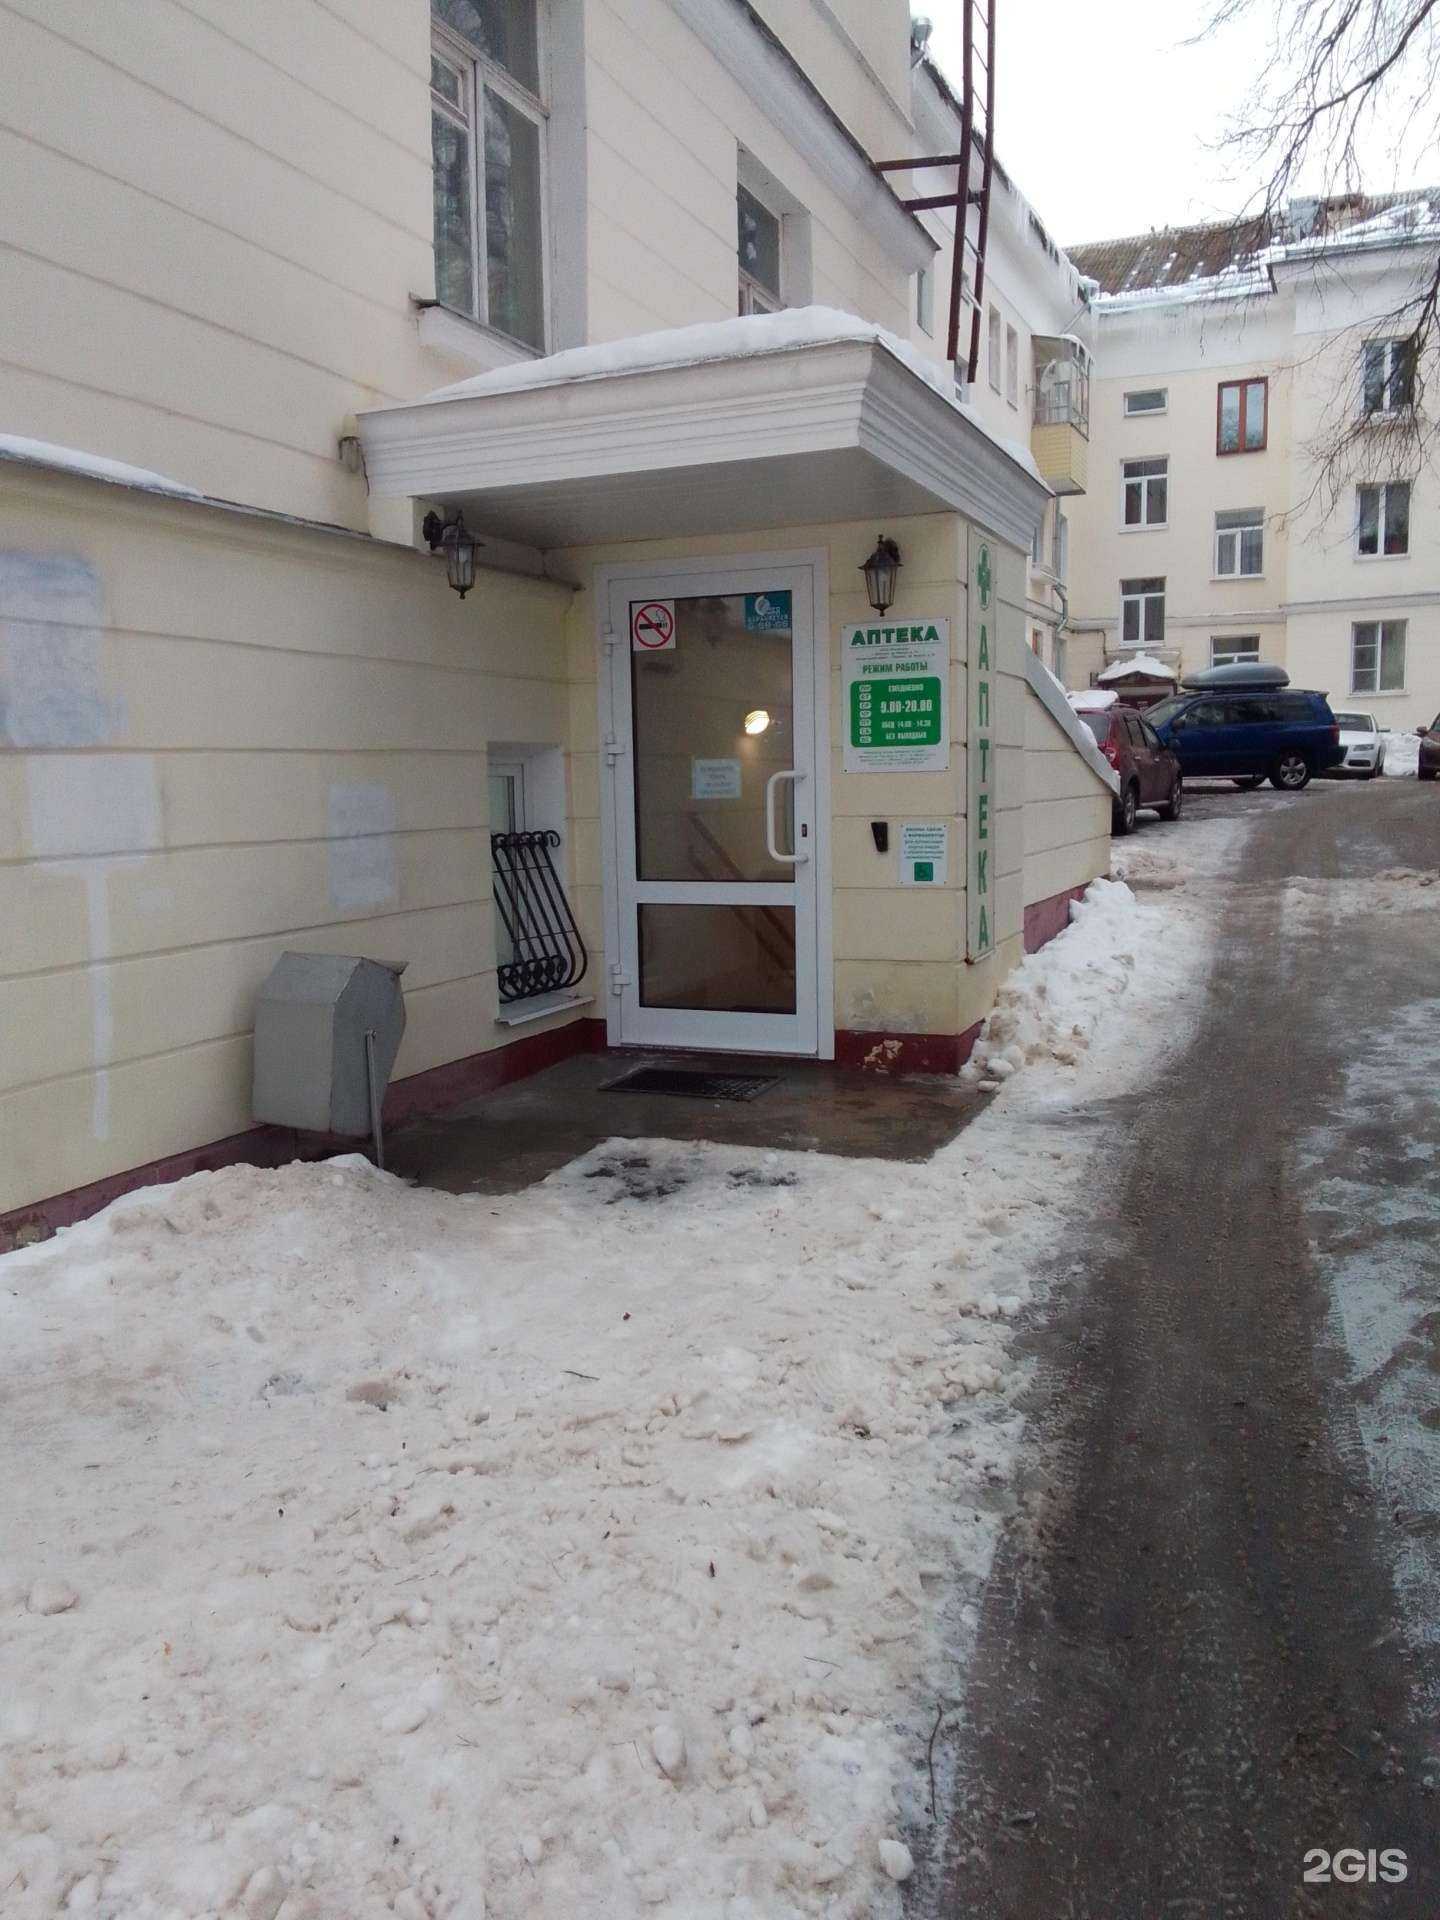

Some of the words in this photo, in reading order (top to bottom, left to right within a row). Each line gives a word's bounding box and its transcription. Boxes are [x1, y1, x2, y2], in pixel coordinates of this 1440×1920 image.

[851, 626, 940, 646] АПТЕКА
[863, 663, 893, 674] РЕЖИМ
[895, 661, 928, 673] РАБОТЫ
[977, 624, 990, 951] АПТЕКА
